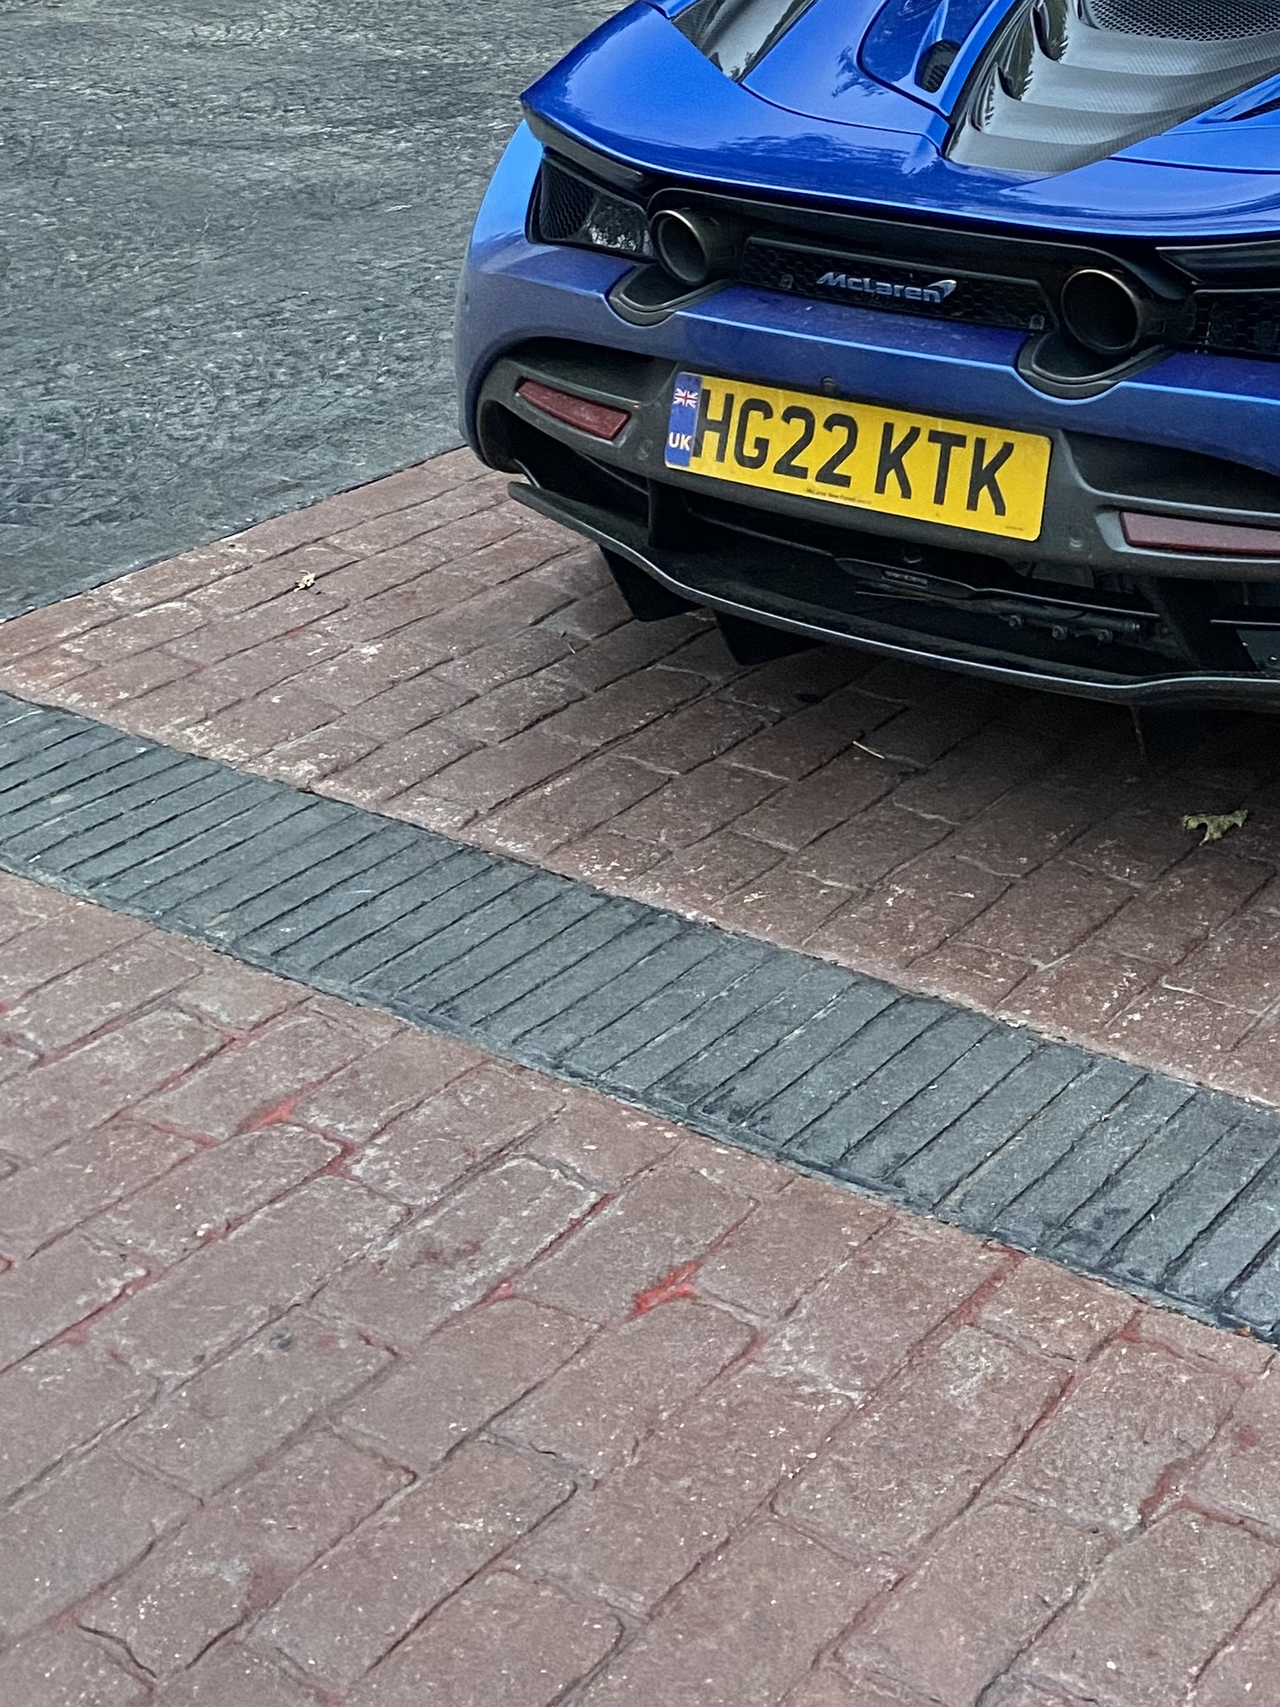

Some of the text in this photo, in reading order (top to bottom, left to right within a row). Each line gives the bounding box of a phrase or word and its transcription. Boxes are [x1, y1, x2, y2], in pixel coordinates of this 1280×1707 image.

[816, 272, 942, 303] McLaren
[668, 433, 691, 452] UK
[692, 388, 1015, 517] HG22 KTK
